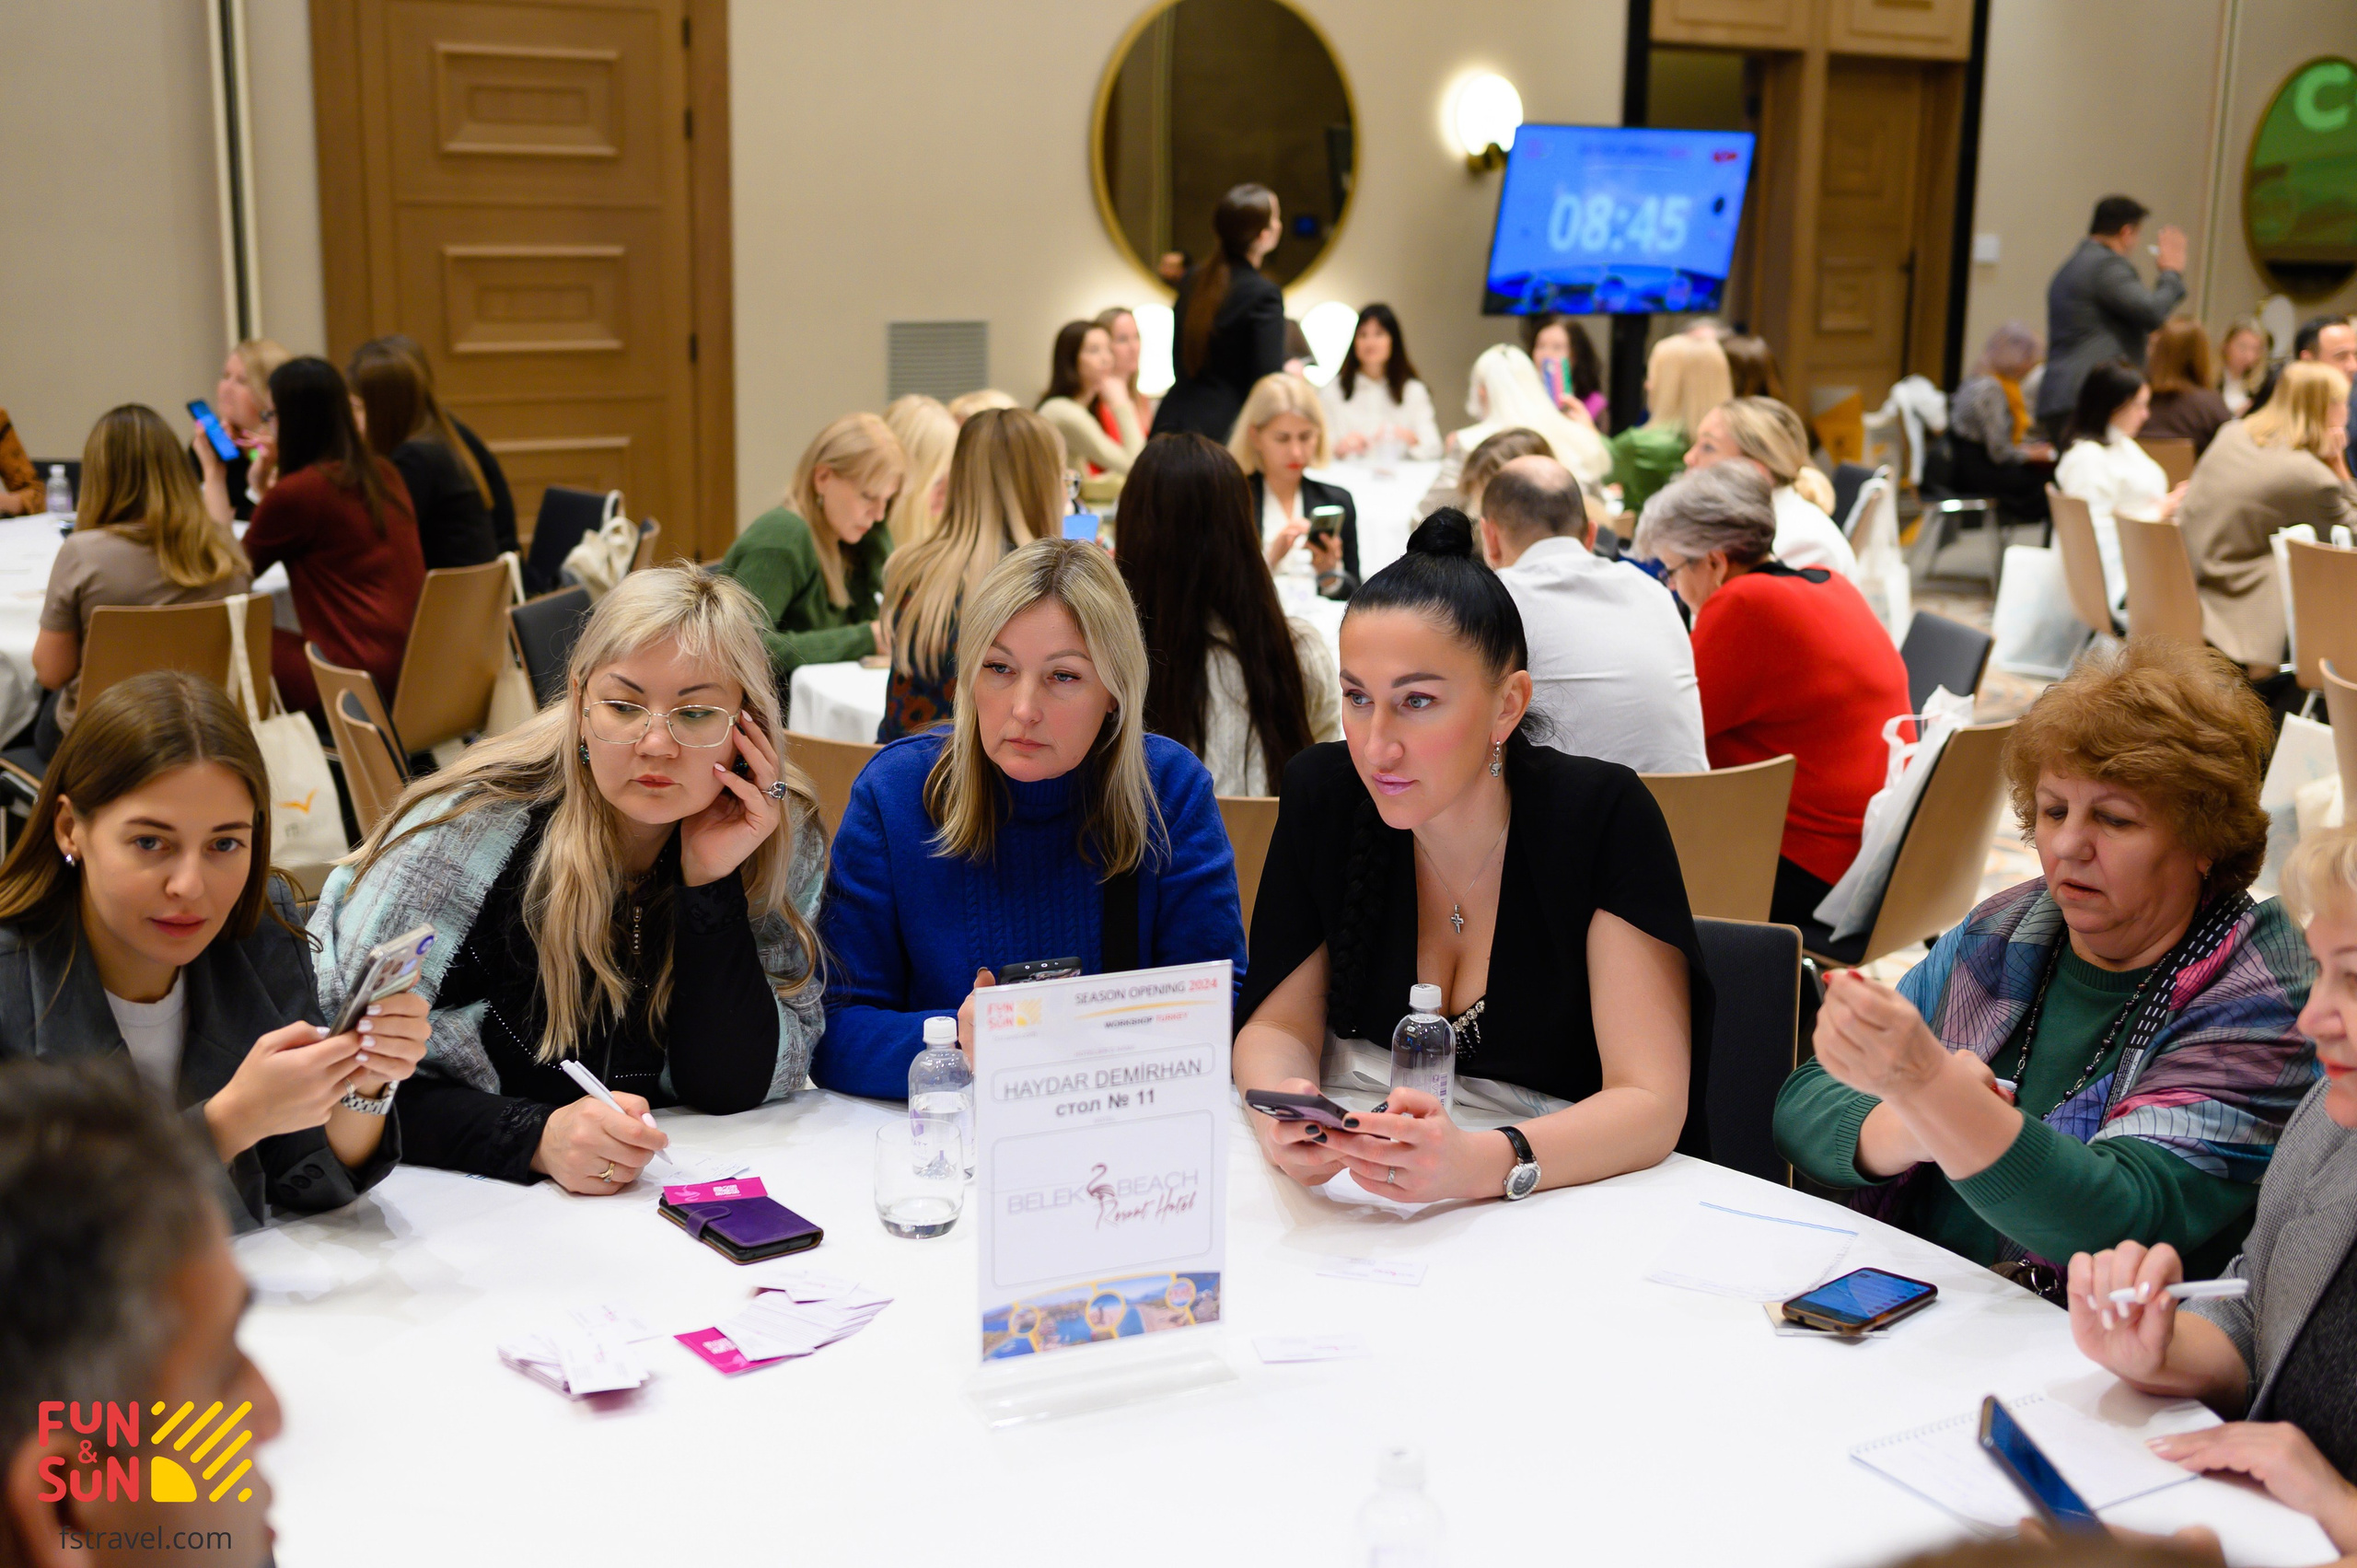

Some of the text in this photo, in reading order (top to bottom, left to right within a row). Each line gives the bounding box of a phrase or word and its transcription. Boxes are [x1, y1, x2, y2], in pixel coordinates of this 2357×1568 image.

[1548, 192, 1691, 253] 08:45
[1074, 977, 1218, 1005] SEASON OPENING 2024
[987, 1002, 1014, 1015] FUN
[1104, 1015, 1154, 1029] WORKSHOP
[1004, 1057, 1202, 1101] HAYDAR DEMİRHAN
[1137, 1087, 1155, 1104] 11
[1007, 1168, 1200, 1215] BELEK BEACH
